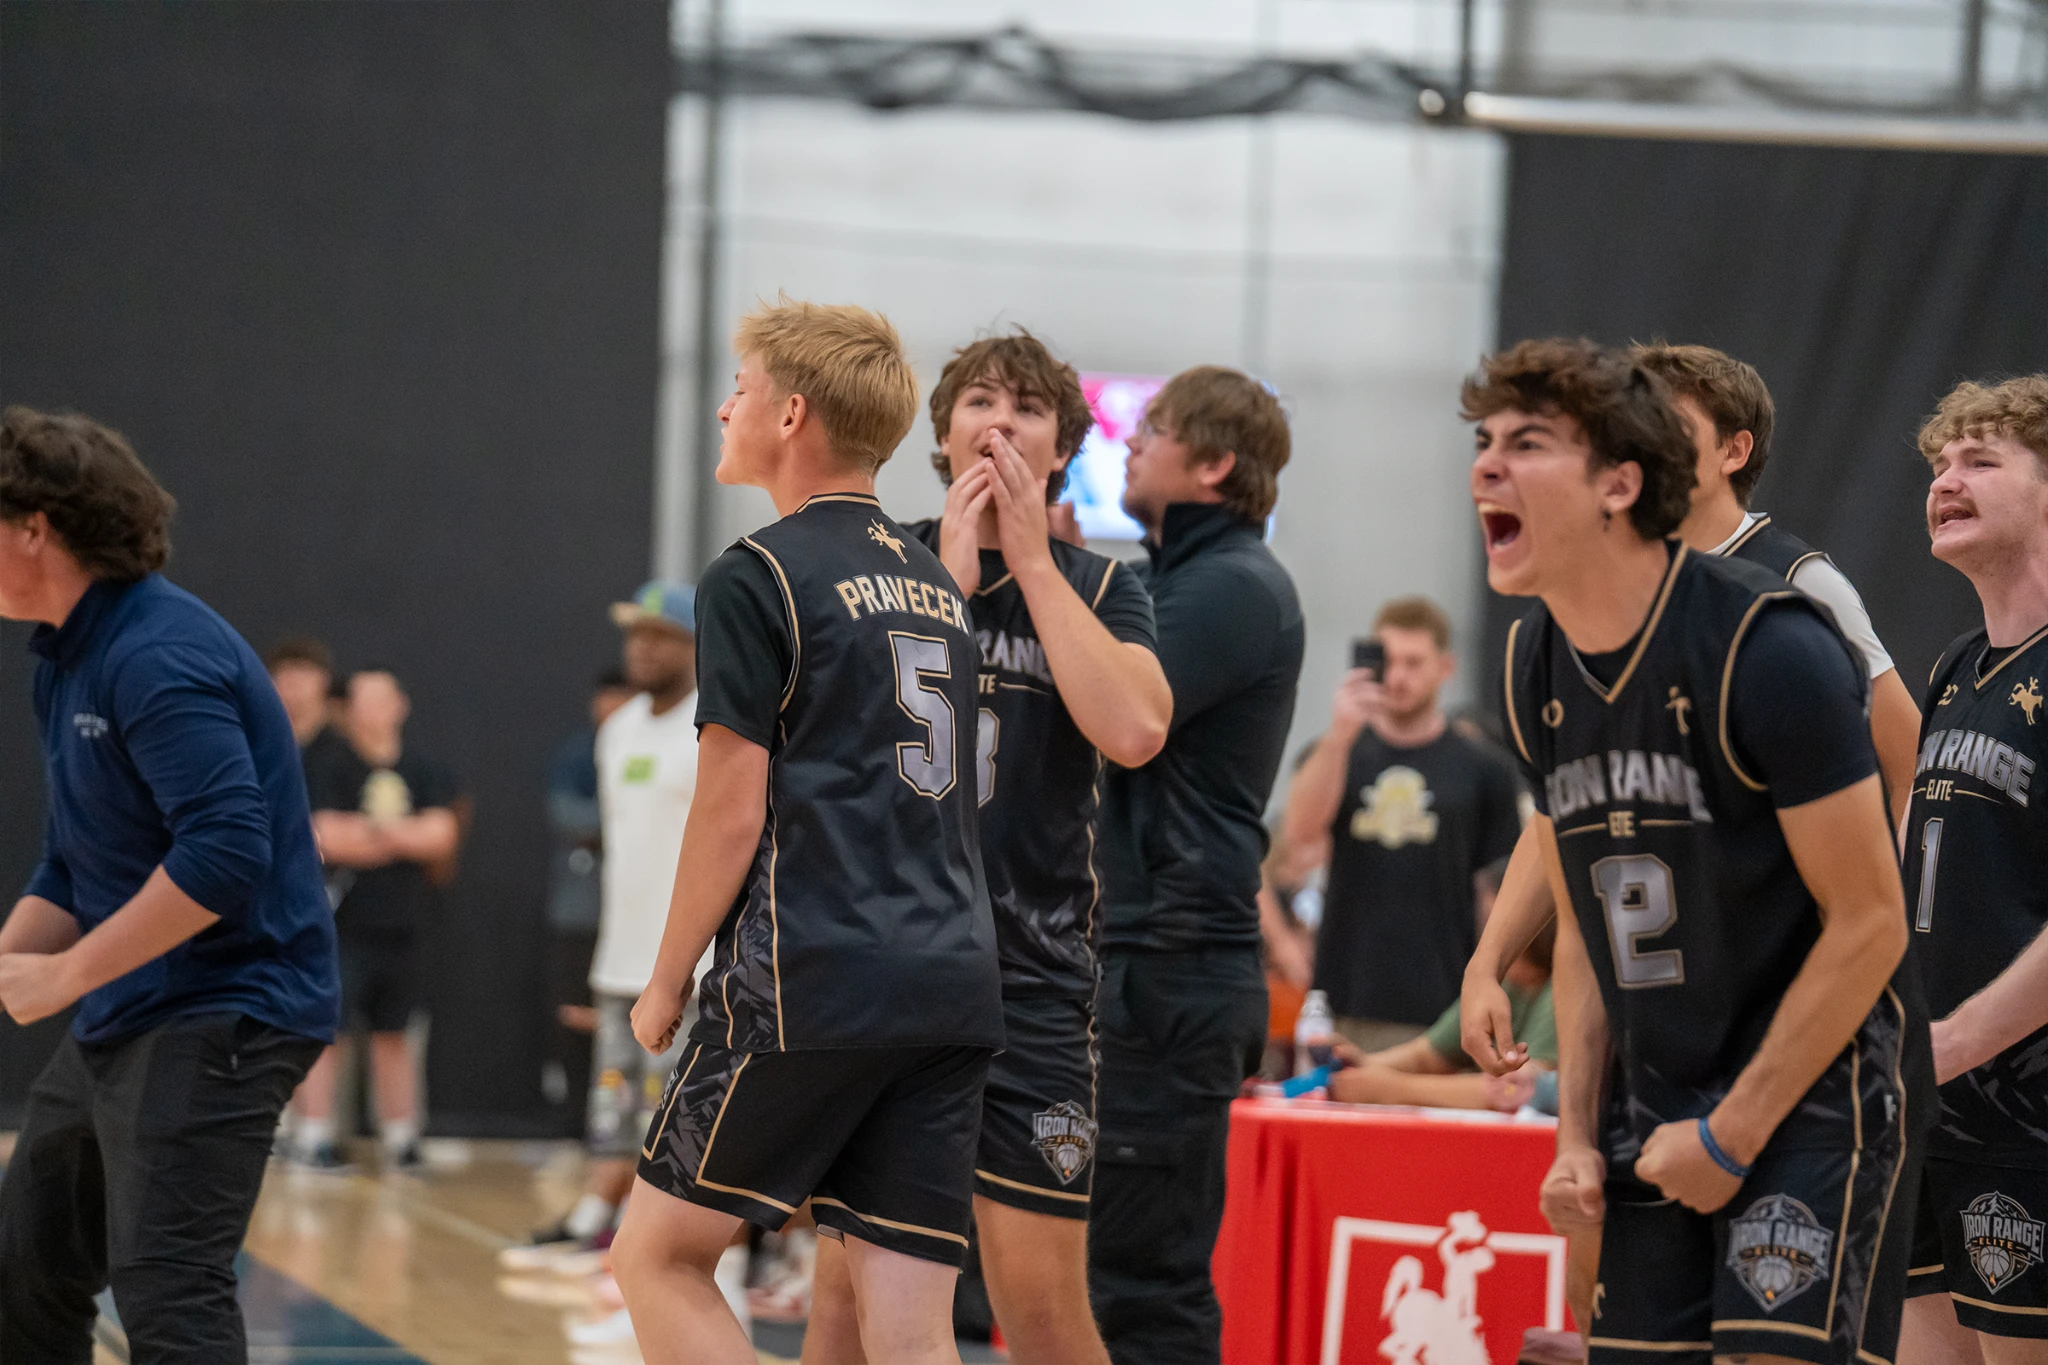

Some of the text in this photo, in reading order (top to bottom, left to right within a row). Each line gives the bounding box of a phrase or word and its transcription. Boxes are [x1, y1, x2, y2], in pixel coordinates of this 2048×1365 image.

[835, 573, 970, 635] PRAVECEK
[888, 631, 957, 801] 5
[1925, 779, 1954, 801] ELITE
[1937, 729, 2036, 808] RANGE
[1915, 817, 1944, 933] 1
[1590, 853, 1686, 989] 2
[1037, 1116, 1069, 1139] IRON
[1964, 1214, 2042, 1254] IRON RANGE
[1979, 1238, 2014, 1250] ELITE
